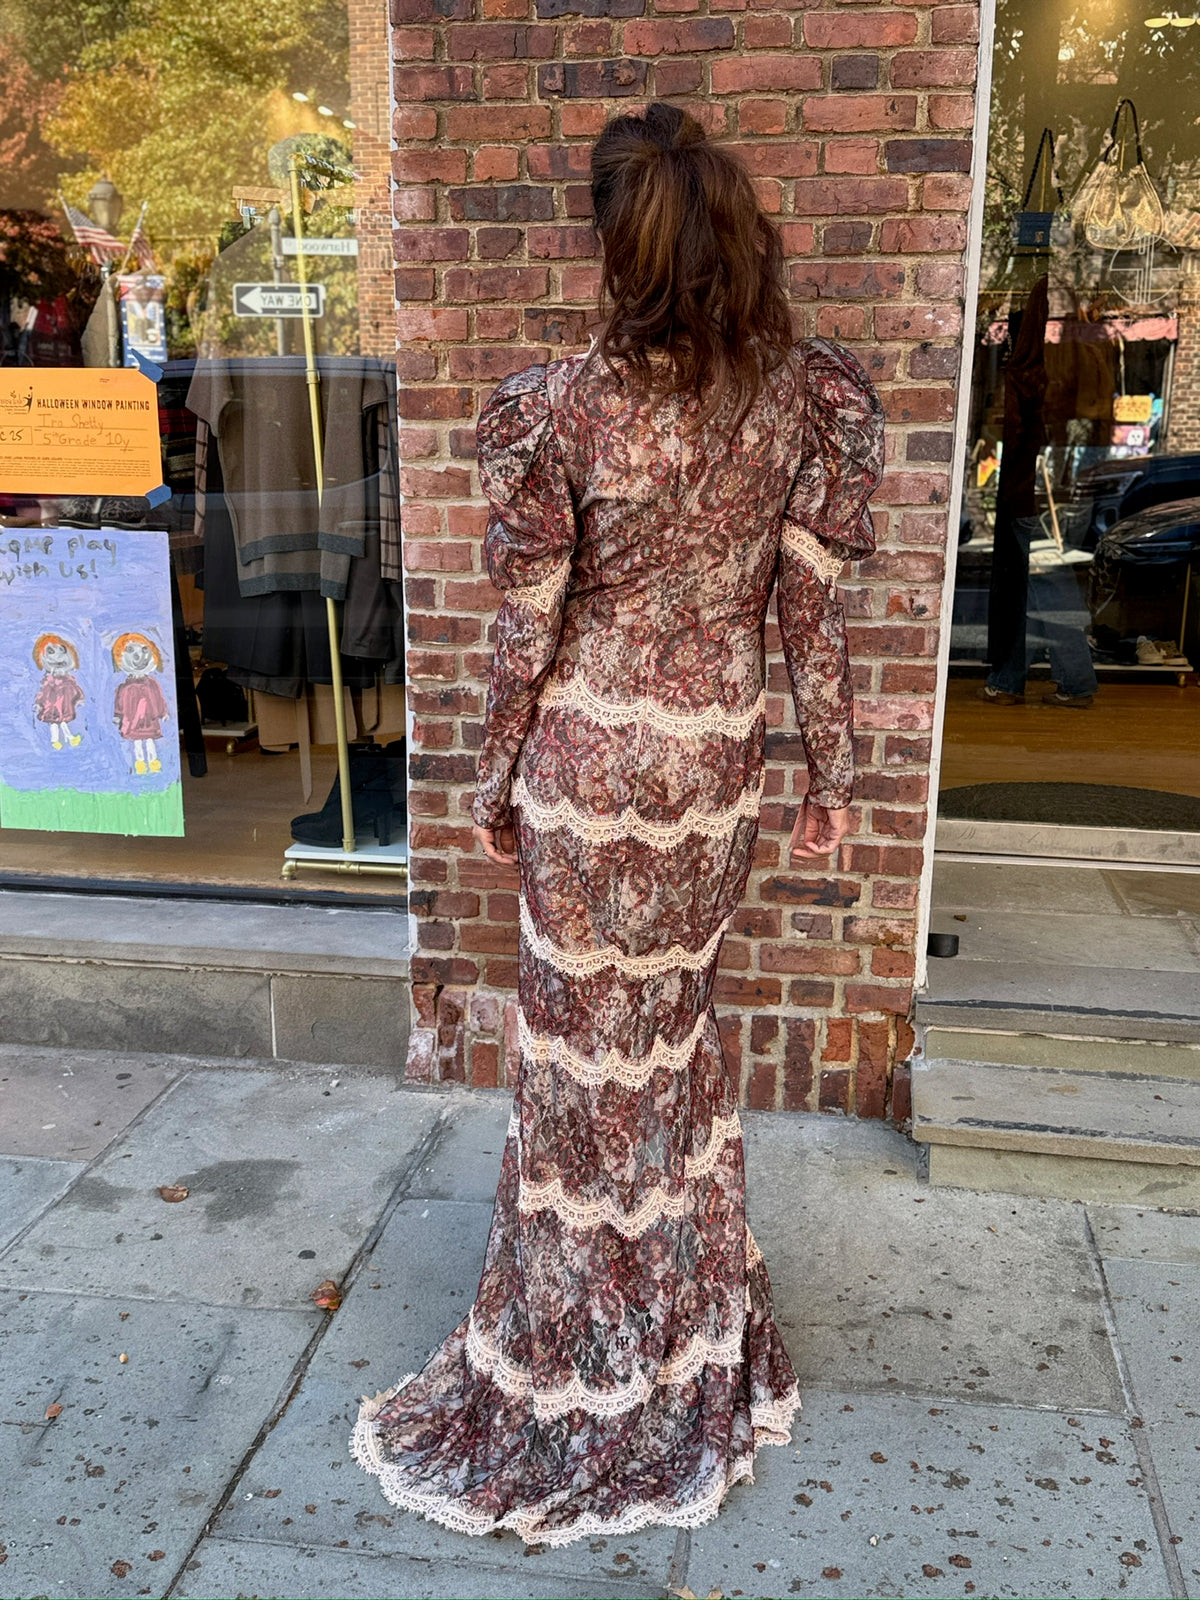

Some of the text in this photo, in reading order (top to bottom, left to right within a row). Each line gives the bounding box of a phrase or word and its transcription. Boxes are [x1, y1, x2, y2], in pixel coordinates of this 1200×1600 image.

[37, 398, 79, 409] HALLOWEEN
[82, 399, 113, 410] WINDOW
[116, 400, 150, 411] PAINTING
[59, 432, 97, 447] Grade
[67, 534, 116, 566] play
[0, 561, 49, 585] with
